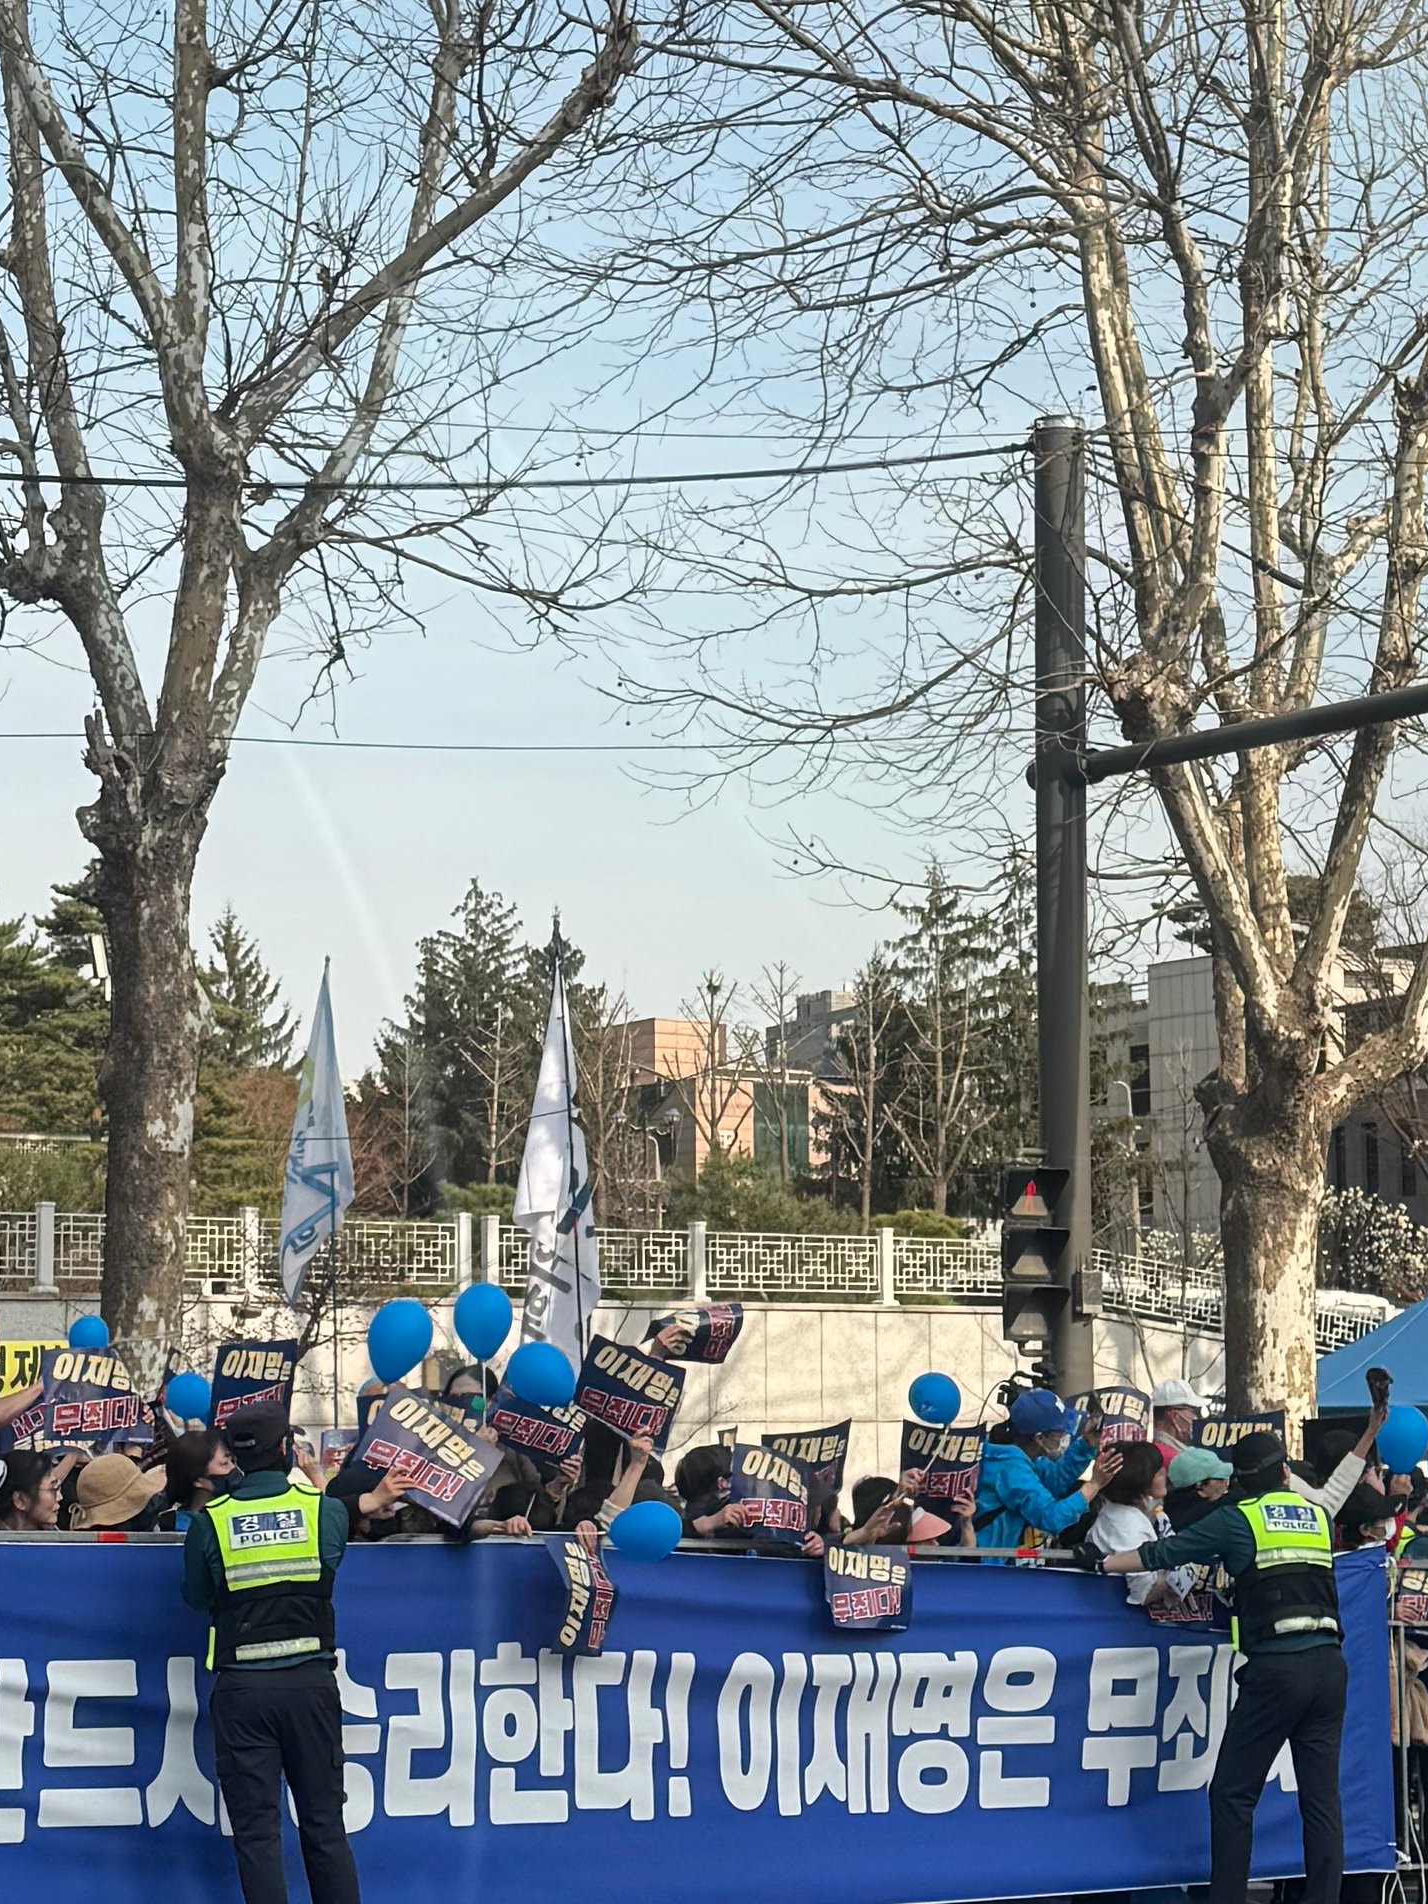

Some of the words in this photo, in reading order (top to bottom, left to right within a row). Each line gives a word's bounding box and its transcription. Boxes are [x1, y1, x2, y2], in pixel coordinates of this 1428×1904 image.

[221, 1349, 292, 1382] 이재명은
[593, 1345, 680, 1408] 이재명은
[53, 1395, 139, 1435] 무죄다!
[492, 1409, 575, 1457] 무죄다!
[580, 1386, 669, 1436] 무죄다!
[388, 1396, 486, 1483] 이재명은
[361, 1438, 466, 1502] 무죄다!
[238, 1510, 299, 1533] 경찰
[240, 1529, 301, 1545] POLICE
[1271, 1520, 1316, 1531] POLICE
[828, 1545, 906, 1586] 이재명은
[717, 1645, 1057, 1817] 이재명은
